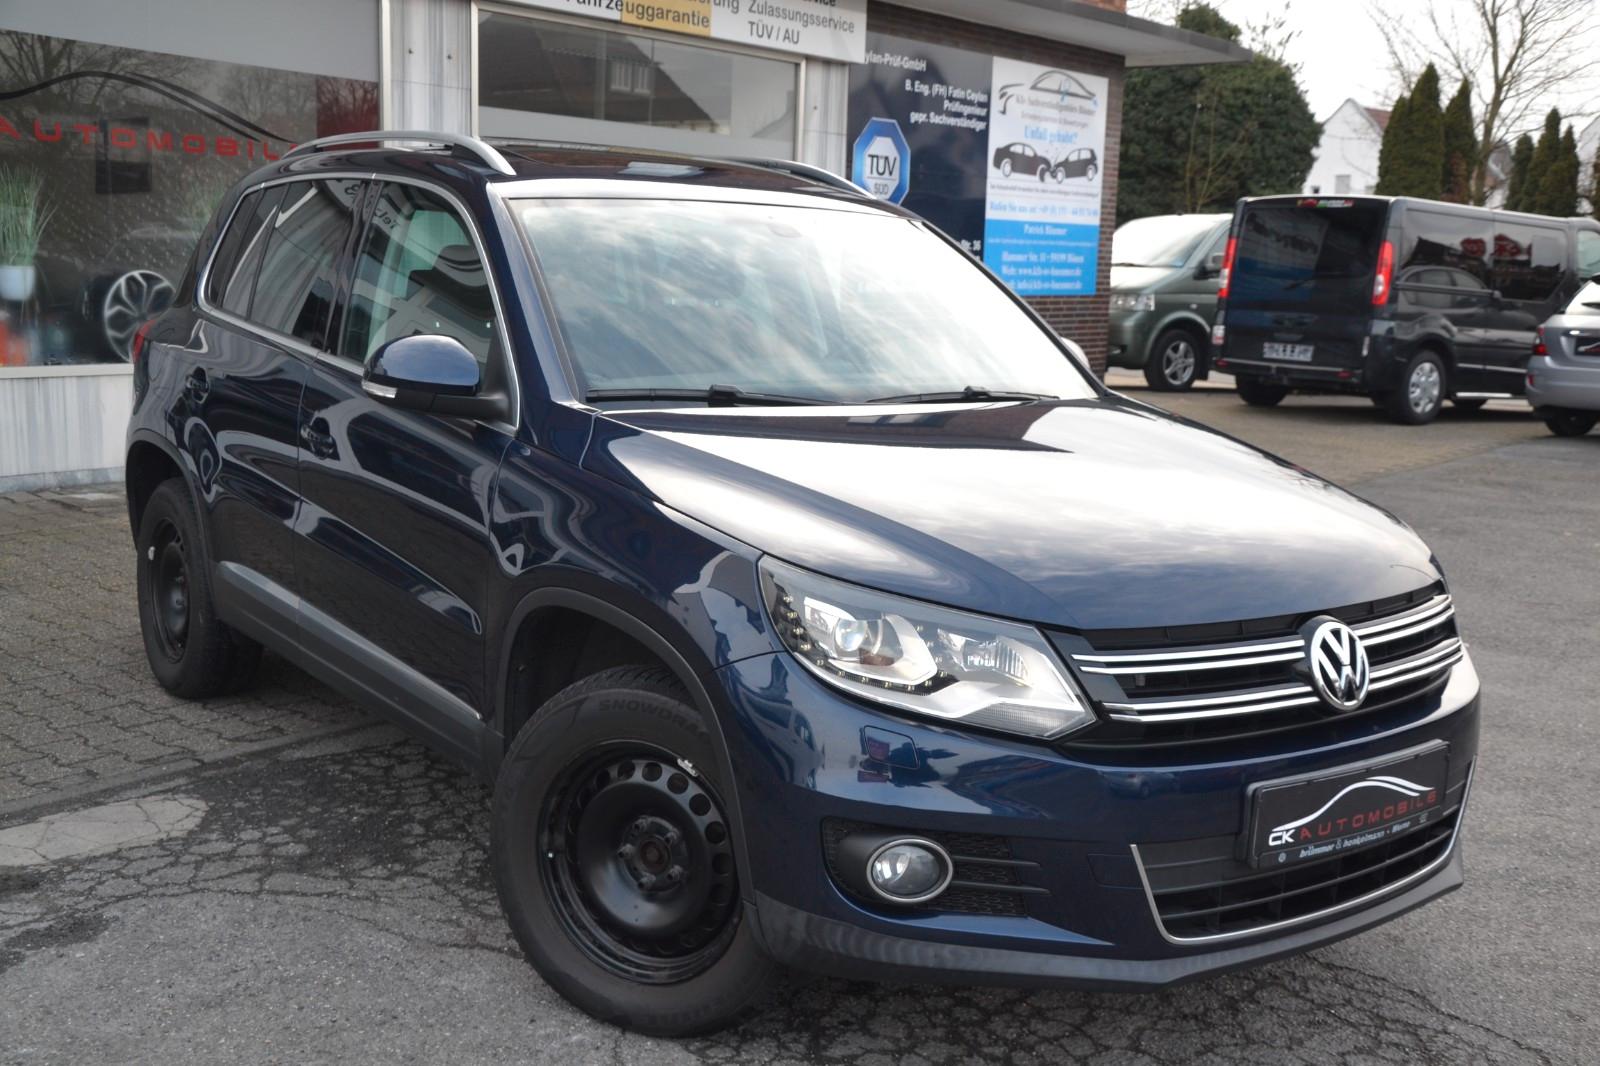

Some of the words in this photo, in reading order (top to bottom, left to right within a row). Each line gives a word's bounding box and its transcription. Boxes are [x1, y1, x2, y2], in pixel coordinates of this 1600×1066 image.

[566, 0, 710, 28] rzeuggarantie
[748, 0, 855, 33] Zulassungsservice
[747, 20, 774, 40] TÜV
[782, 28, 801, 45] AU
[929, 112, 987, 132] Sachverständiger
[0, 113, 298, 161] AUTOMOBIL
[868, 154, 897, 177] TÜV
[1268, 829, 1297, 847] CK
